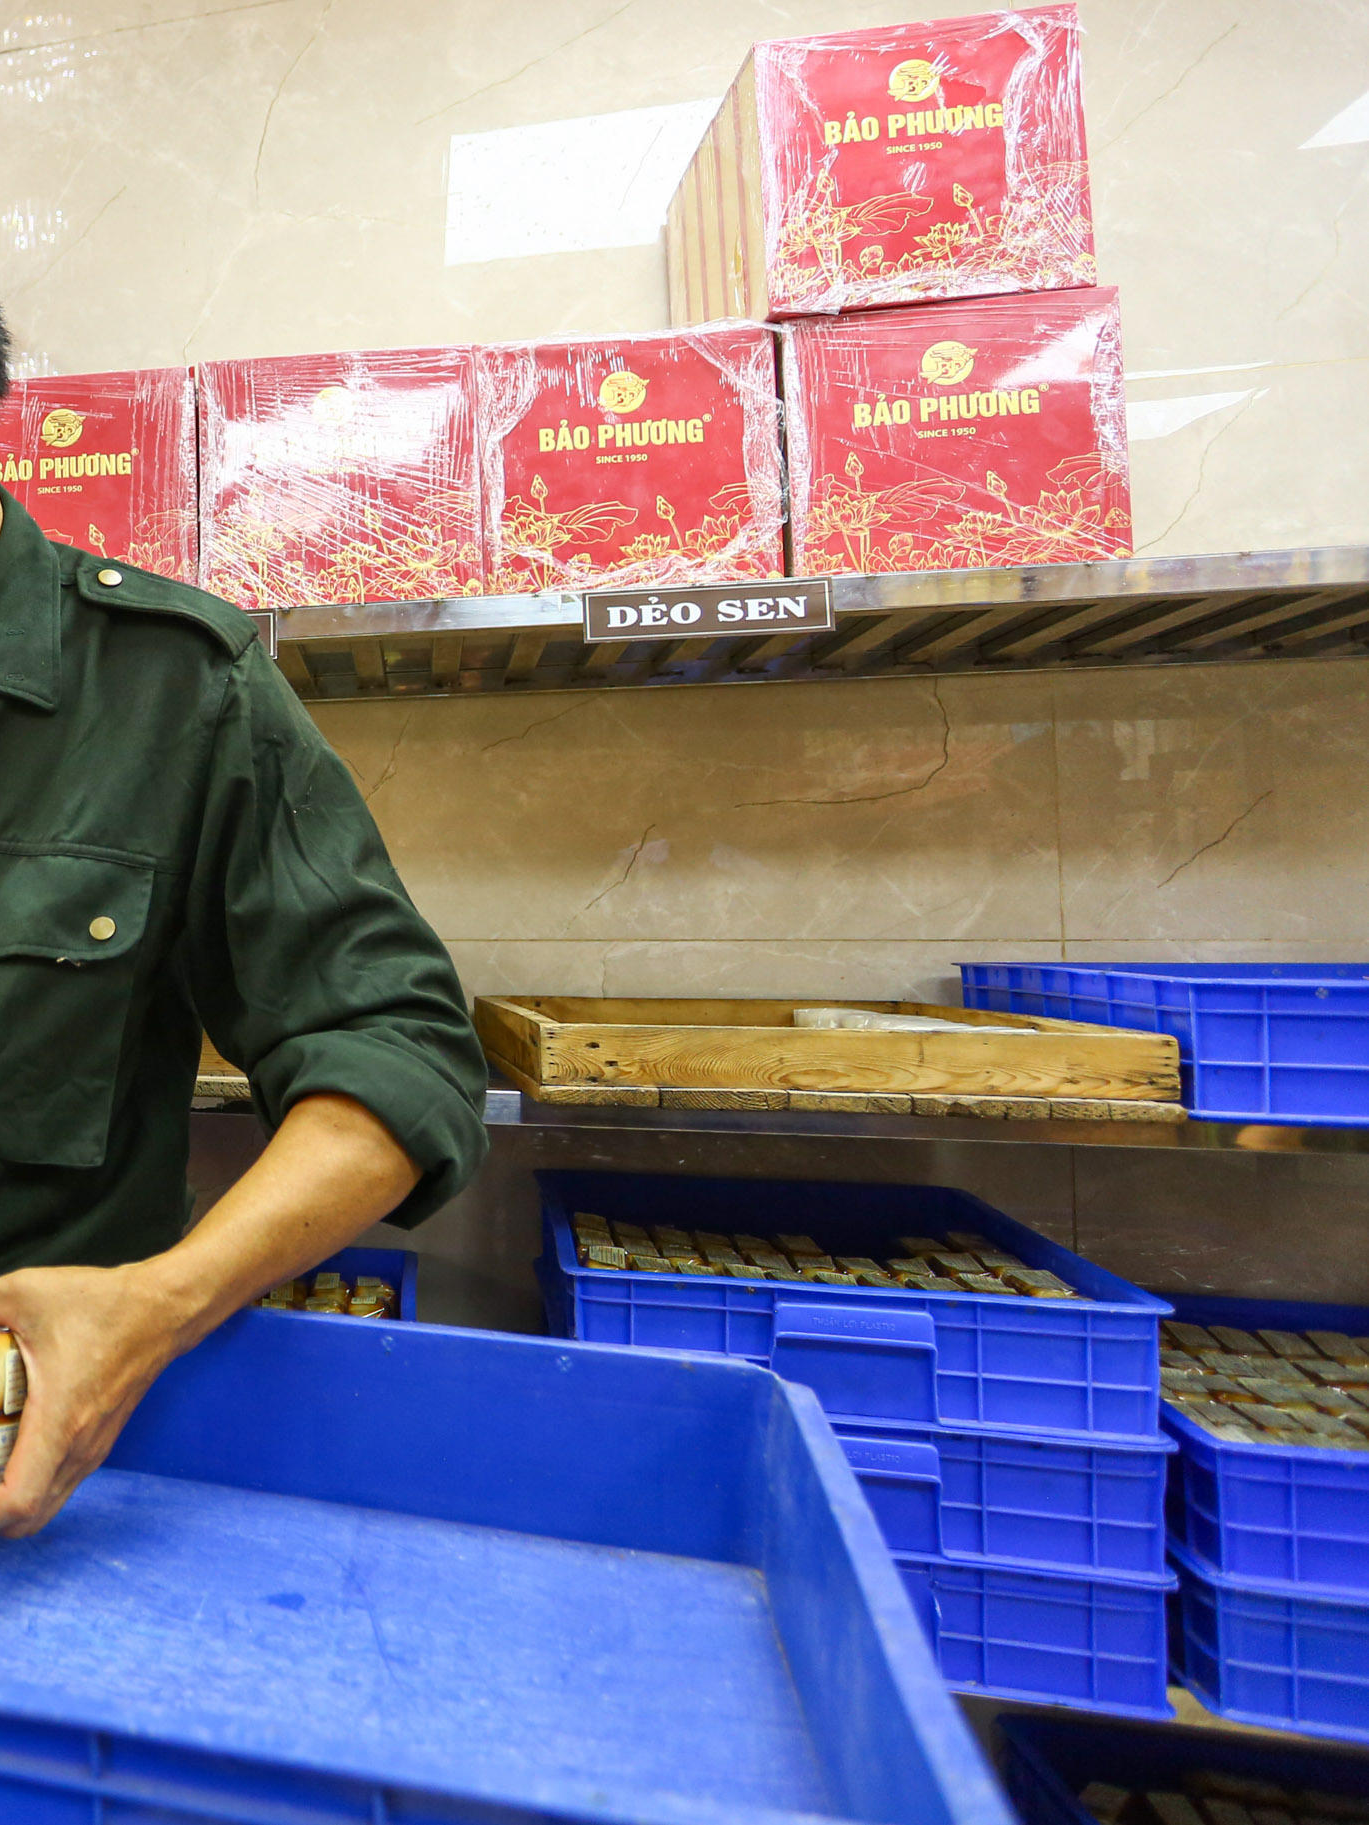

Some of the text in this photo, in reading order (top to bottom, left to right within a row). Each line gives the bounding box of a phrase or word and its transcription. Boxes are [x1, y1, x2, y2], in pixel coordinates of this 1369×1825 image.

[824, 103, 1005, 145] BẢO PHƯƠNG
[886, 141, 943, 154] SINCE 1950
[853, 389, 1040, 428] BẢO PHƯƠNG
[539, 418, 704, 452] BẢO PHƯƠNG
[918, 426, 976, 439] SINCE 1950
[39, 453, 132, 480] PHƯƠNG
[595, 453, 648, 464] SINCE 1950
[37, 485, 83, 495] SINCE 1950
[606, 595, 807, 628] DẺO SEN
